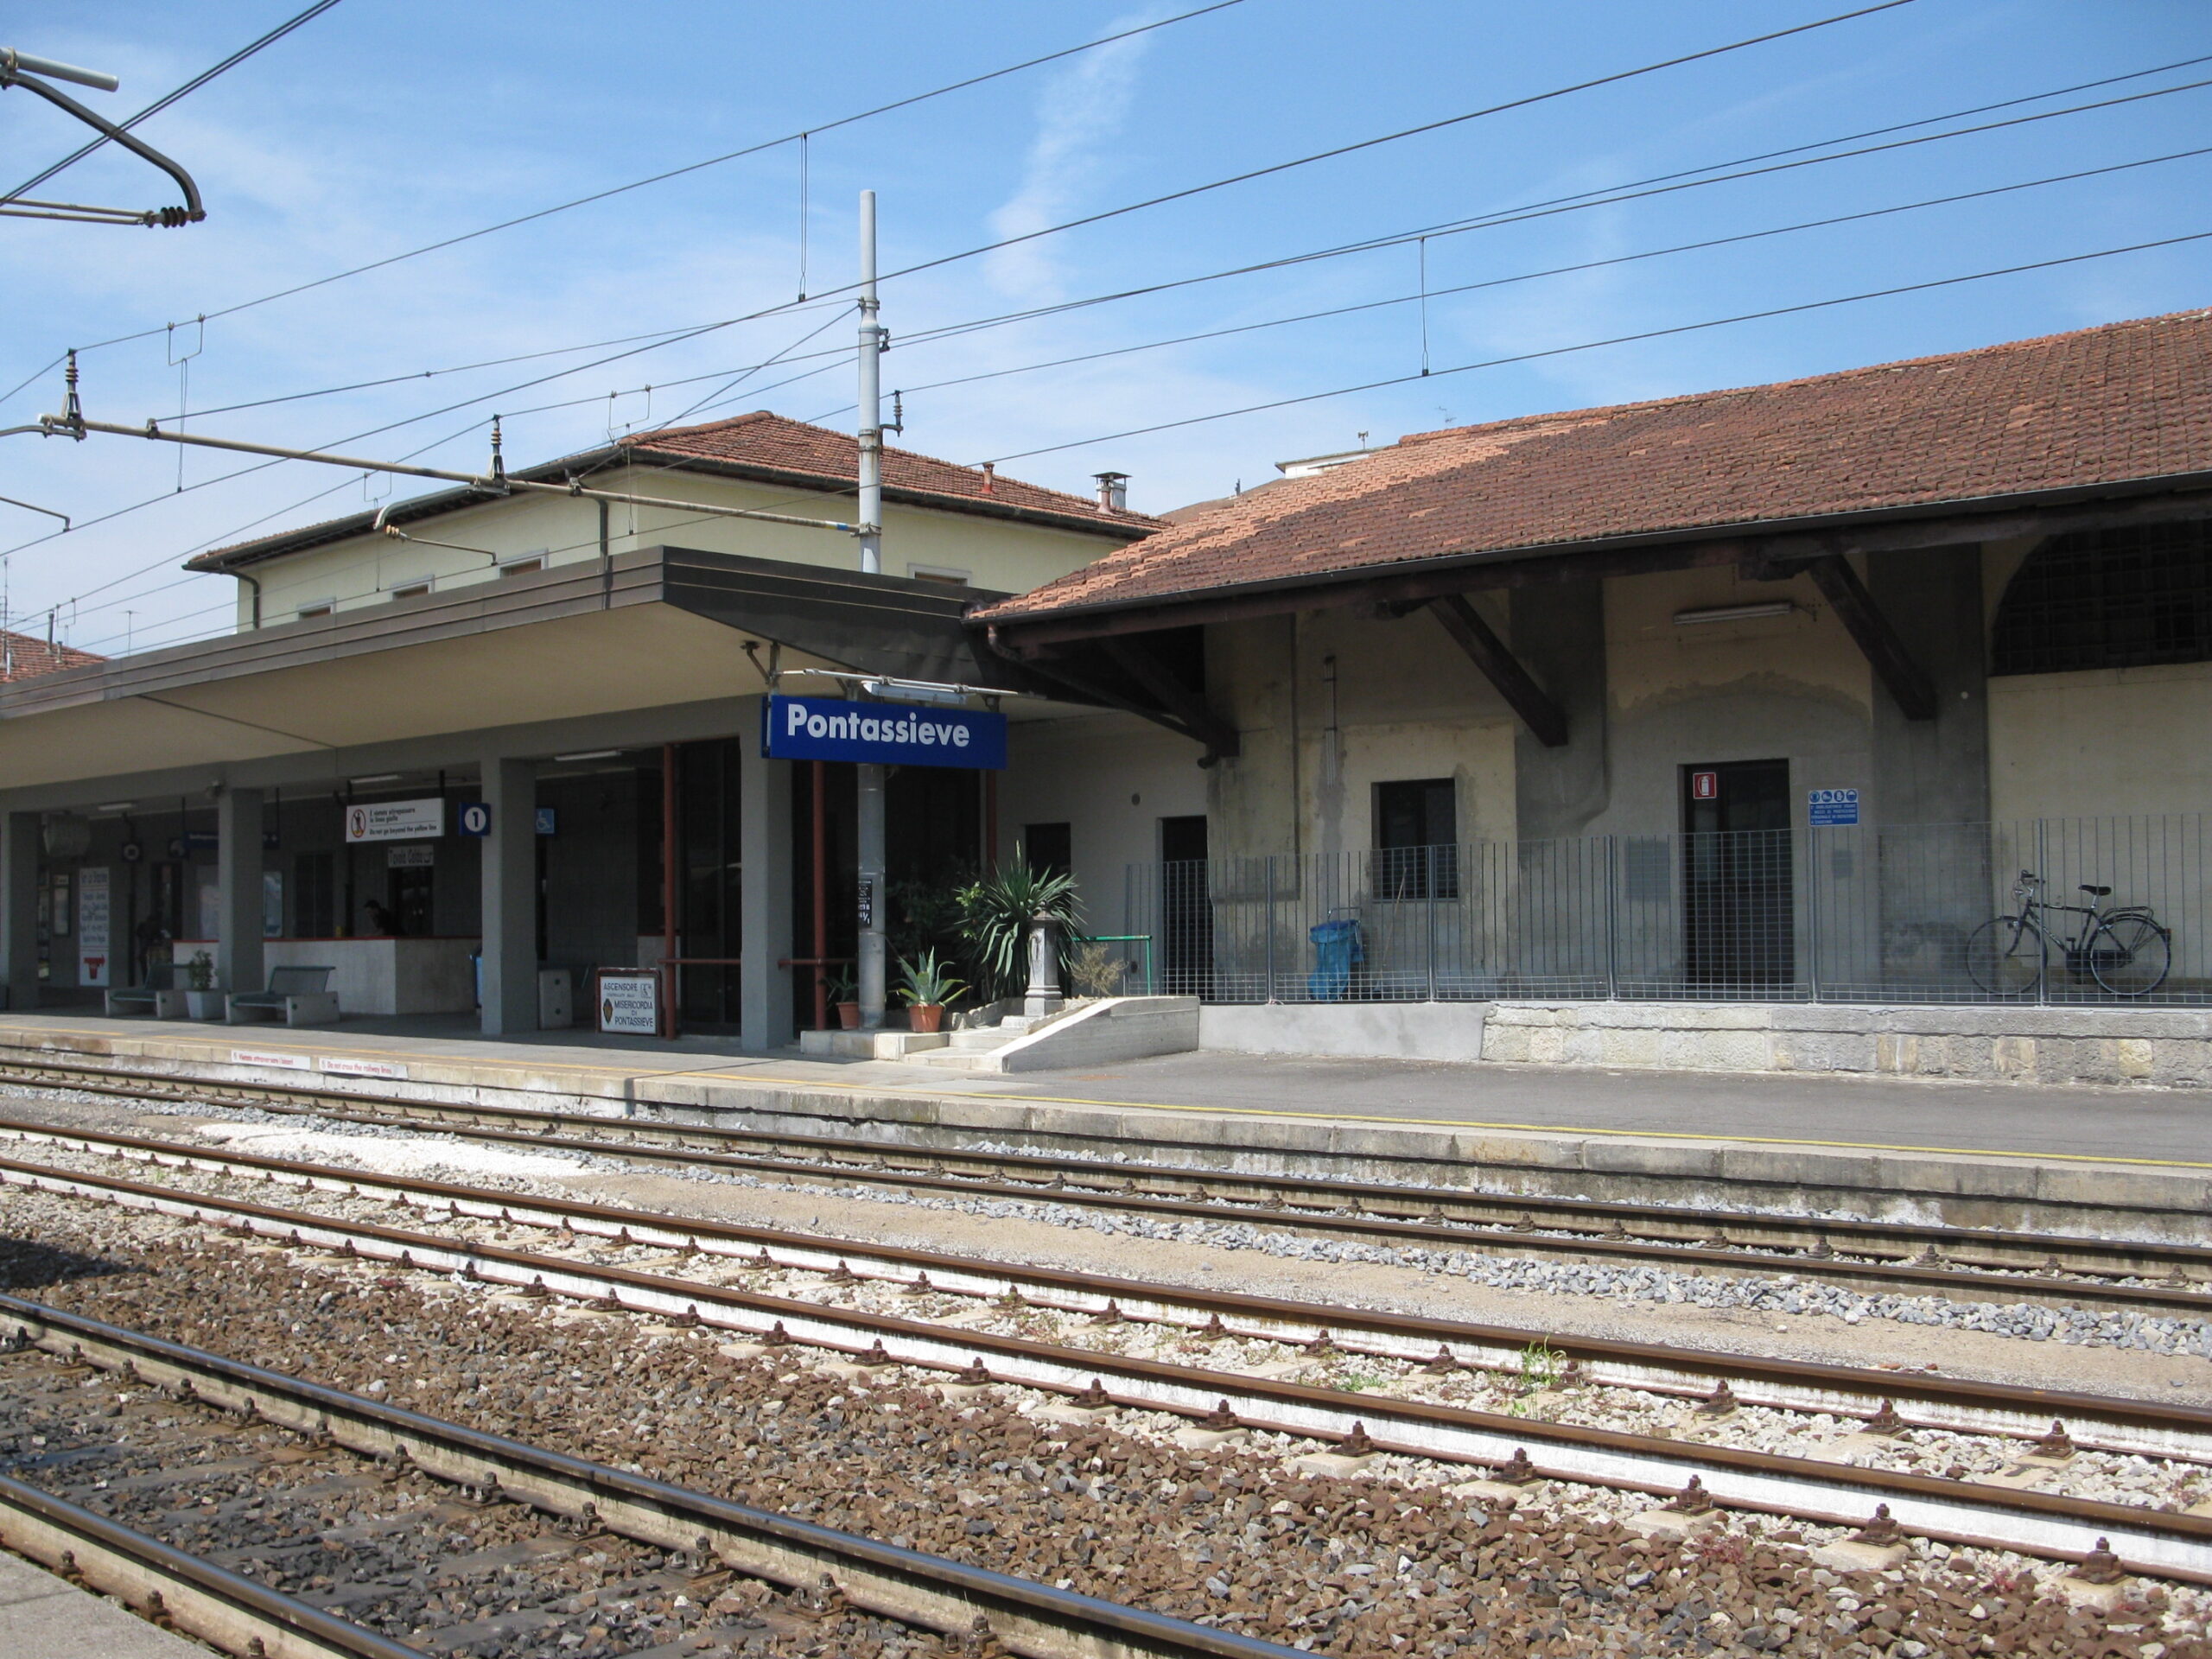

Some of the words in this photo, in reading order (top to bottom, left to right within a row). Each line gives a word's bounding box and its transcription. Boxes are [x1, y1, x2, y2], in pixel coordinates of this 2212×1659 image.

[787, 703, 970, 747] Pontassieve
[473, 811, 479, 828] 1
[390, 826, 406, 836] beyond
[414, 824, 428, 833] yellow
[604, 982, 638, 991] ASCENSORE
[614, 1000, 653, 1009] MISERICORDIA
[615, 1016, 653, 1027] PONTASSIEVE
[363, 1065, 380, 1074] railway
[381, 1065, 392, 1074] lines
